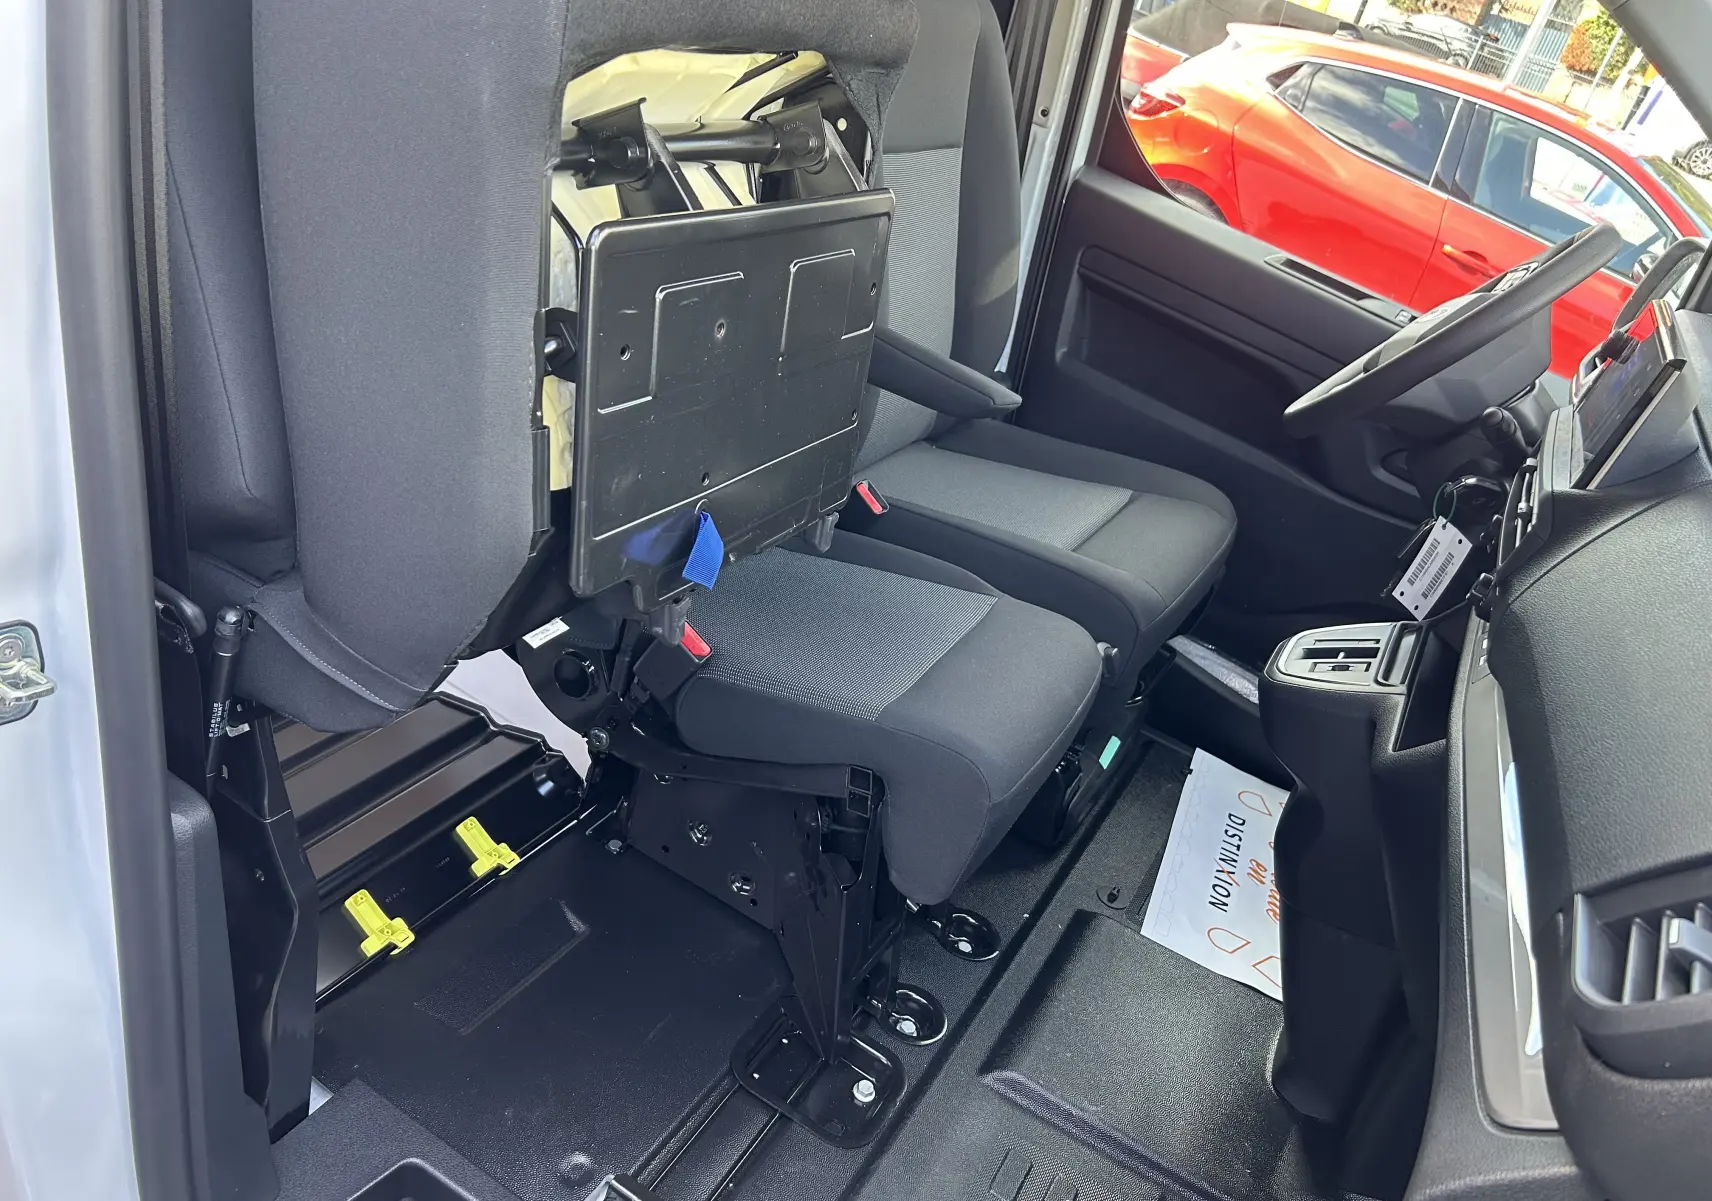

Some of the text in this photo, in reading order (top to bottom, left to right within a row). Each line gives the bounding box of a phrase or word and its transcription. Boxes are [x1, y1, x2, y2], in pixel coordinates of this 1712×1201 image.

[209, 702, 219, 737] STABILUS
[1208, 812, 1246, 913] DISTINXION
[1247, 859, 1268, 886] en
